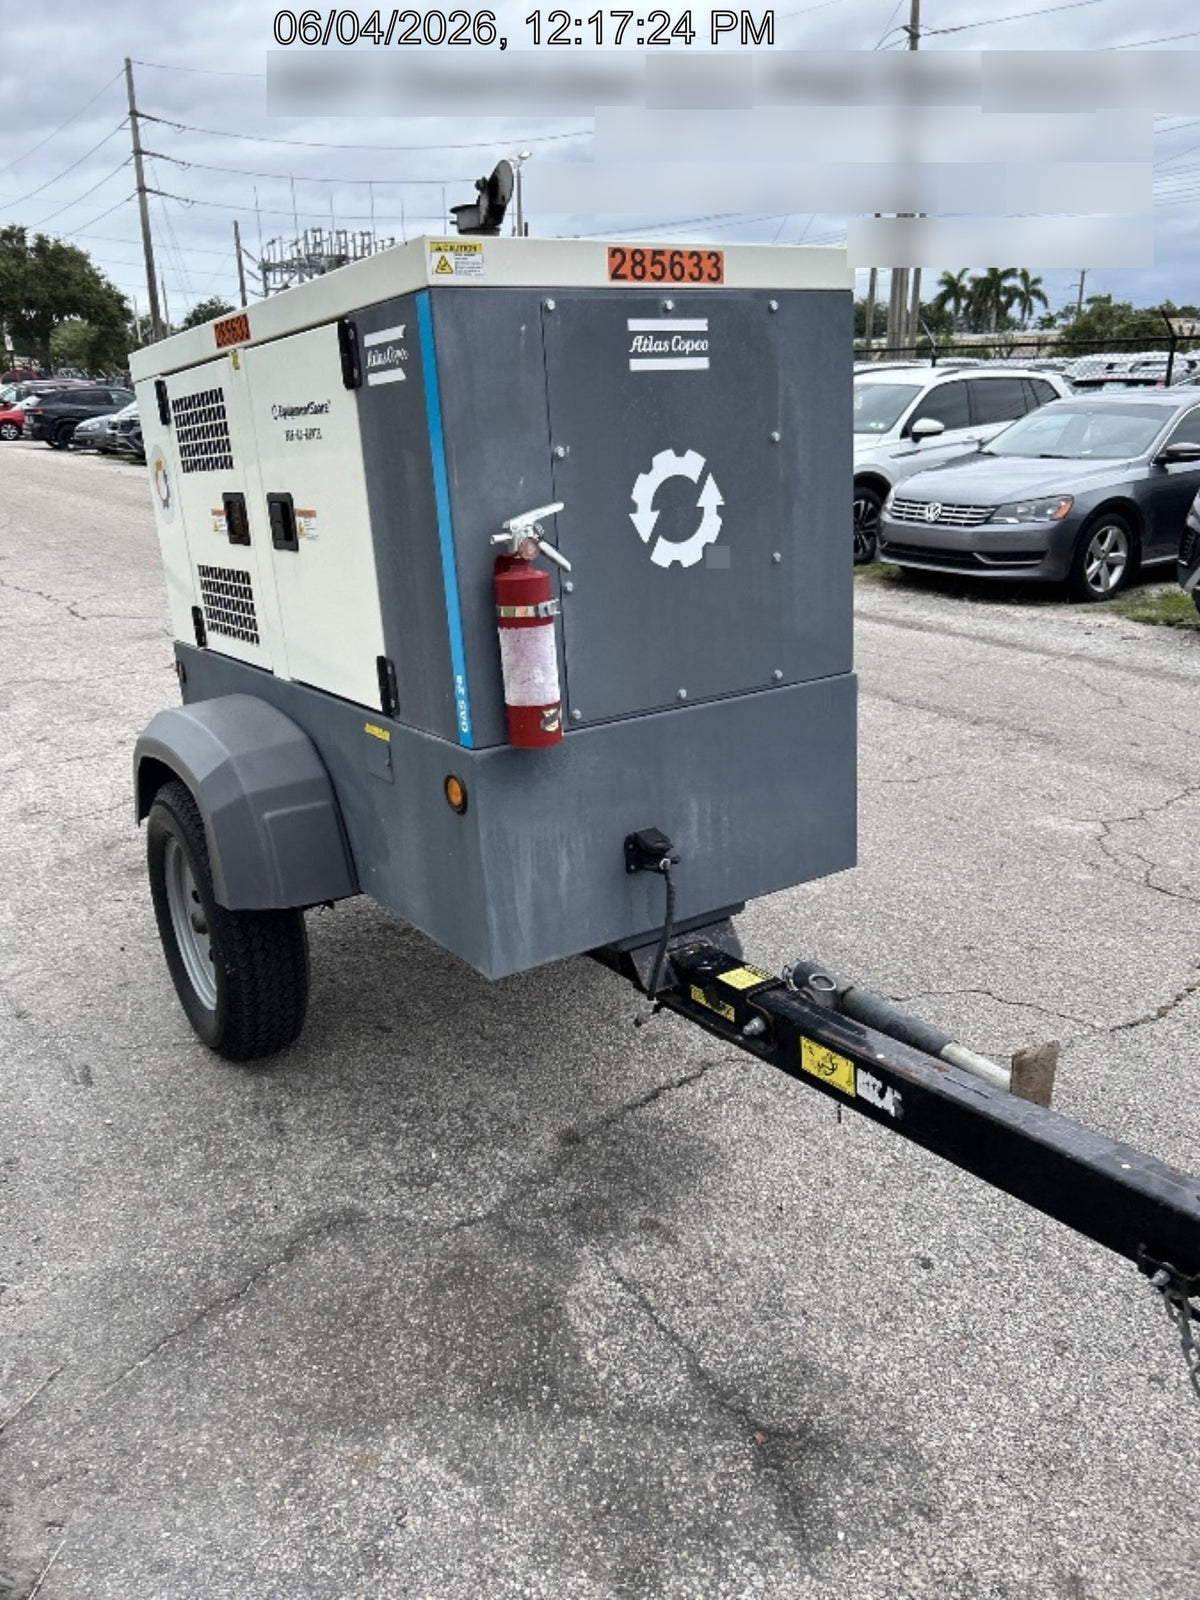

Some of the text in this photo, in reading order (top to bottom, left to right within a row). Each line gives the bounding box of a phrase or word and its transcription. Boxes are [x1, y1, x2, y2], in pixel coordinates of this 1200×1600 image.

[609, 247, 721, 282] 285633
[629, 335, 709, 355] Atlas Copco
